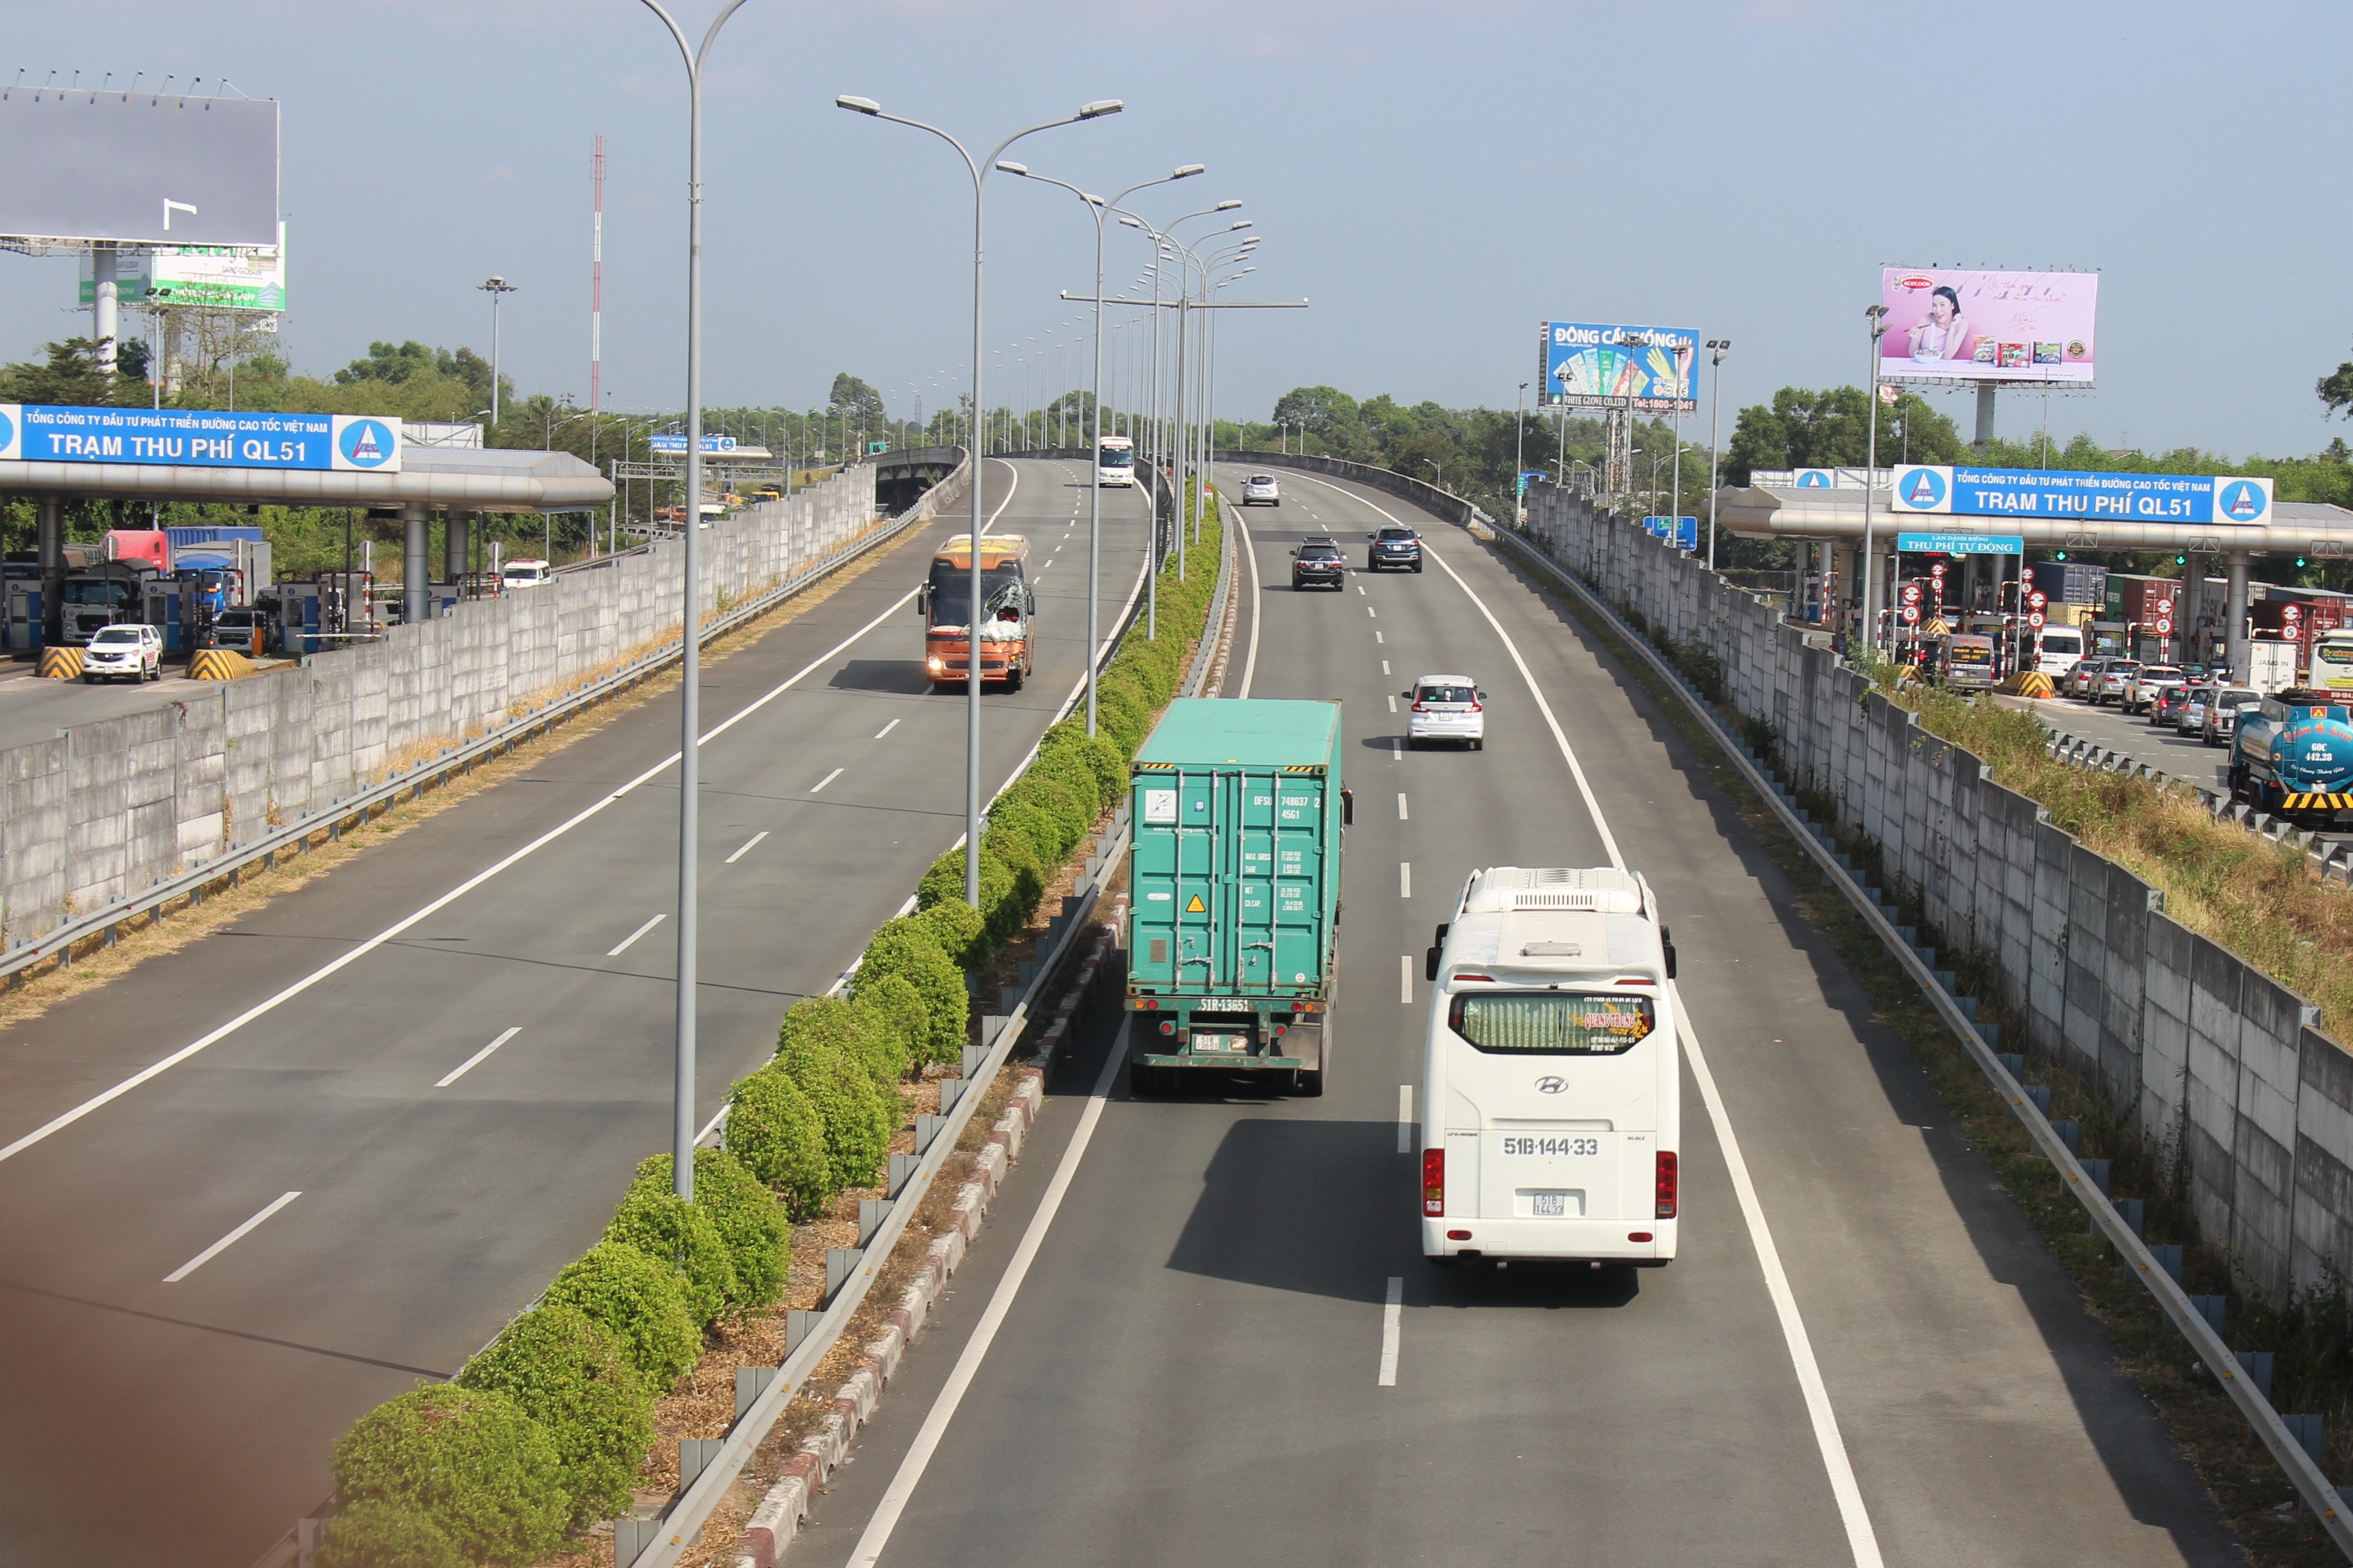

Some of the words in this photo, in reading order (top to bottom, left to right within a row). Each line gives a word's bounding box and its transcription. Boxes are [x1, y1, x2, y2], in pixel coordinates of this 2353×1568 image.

[1583, 395, 1603, 406] GLOVE
[26, 408, 54, 424] TỔNG
[57, 411, 85, 425] CÔNG
[87, 415, 101, 425] TY
[126, 416, 139, 427] TƯ
[141, 415, 167, 427] PHÁT
[170, 413, 199, 429] TRIỂN
[201, 417, 237, 430] ĐƯỜNG
[239, 421, 259, 431] CAO
[261, 417, 281, 432] TỐC
[283, 421, 304, 434] VIỆT
[306, 422, 328, 432] NAM
[48, 434, 123, 459] TRẠM
[130, 436, 183, 458] THU
[191, 434, 236, 460] PHÍ
[243, 439, 305, 462] QL51
[1957, 470, 1980, 483] TỔNG
[1982, 473, 2006, 484] CÔNG
[2007, 475, 2017, 484] TY
[2039, 476, 2050, 486] TƯ
[2051, 475, 2073, 487] PHÁT
[2075, 475, 2099, 488] TRIỂN
[2101, 478, 2131, 489] ĐƯỜNG
[2133, 481, 2151, 490] CAO
[2153, 477, 2171, 491] TỐC
[2172, 479, 2190, 493] VIỆT
[2191, 482, 2210, 492] NAM
[1975, 491, 2037, 512] TRẠM
[2044, 493, 2088, 512] THU
[2095, 492, 2134, 514] PHÍ
[2138, 496, 2191, 516] QL51
[1907, 541, 1932, 550] THU
[1936, 540, 1955, 550] PHÍ
[1957, 541, 1975, 552] TỰ
[1978, 543, 2013, 553] ĐỘNG
[1907, 609, 1914, 618] 5
[2033, 615, 2040, 624] 5
[2160, 621, 2167, 630] 5
[2286, 628, 2294, 637] 5
[2311, 742, 2327, 751] 60C
[2304, 752, 2333, 761] 442.28
[1254, 795, 1273, 806] DFSU
[1280, 796, 1309, 806] 748637
[1314, 797, 1320, 808] 2
[1281, 809, 1300, 820] 45G1
[1584, 1013, 1610, 1030] QUANG
[1611, 1013, 1635, 1028] TRUNG
[1541, 1195, 1557, 1205] 51B
